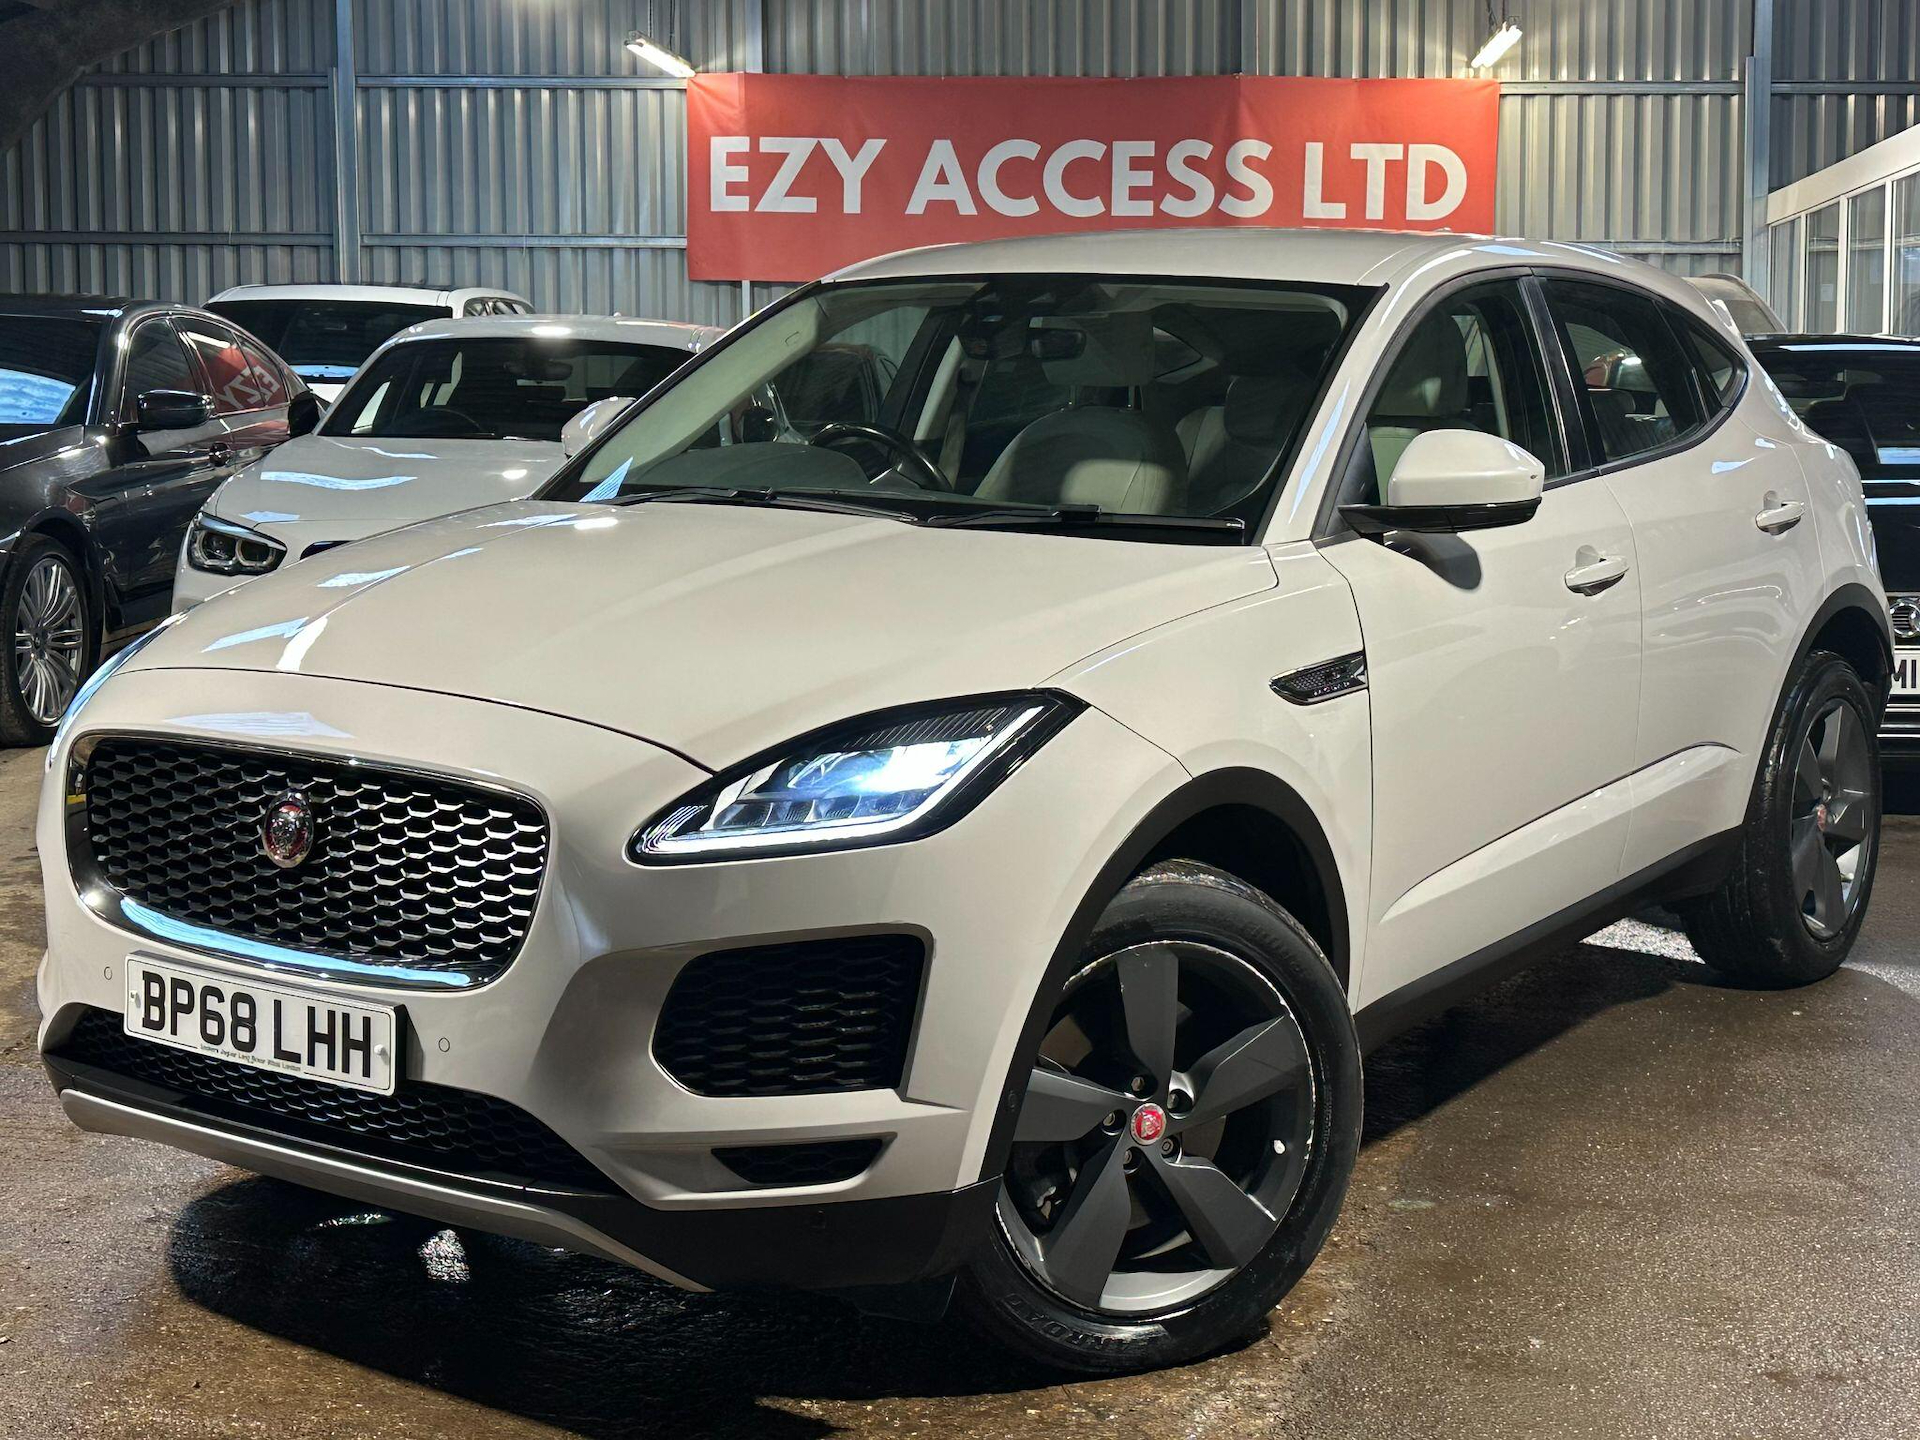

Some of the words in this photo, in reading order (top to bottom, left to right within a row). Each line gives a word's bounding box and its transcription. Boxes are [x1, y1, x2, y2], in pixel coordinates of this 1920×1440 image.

[709, 136, 888, 214] EZY
[904, 139, 1274, 219] ACCESS
[1303, 142, 1468, 221] LTD
[142, 970, 257, 1053] BP68
[273, 999, 372, 1079] LHH
